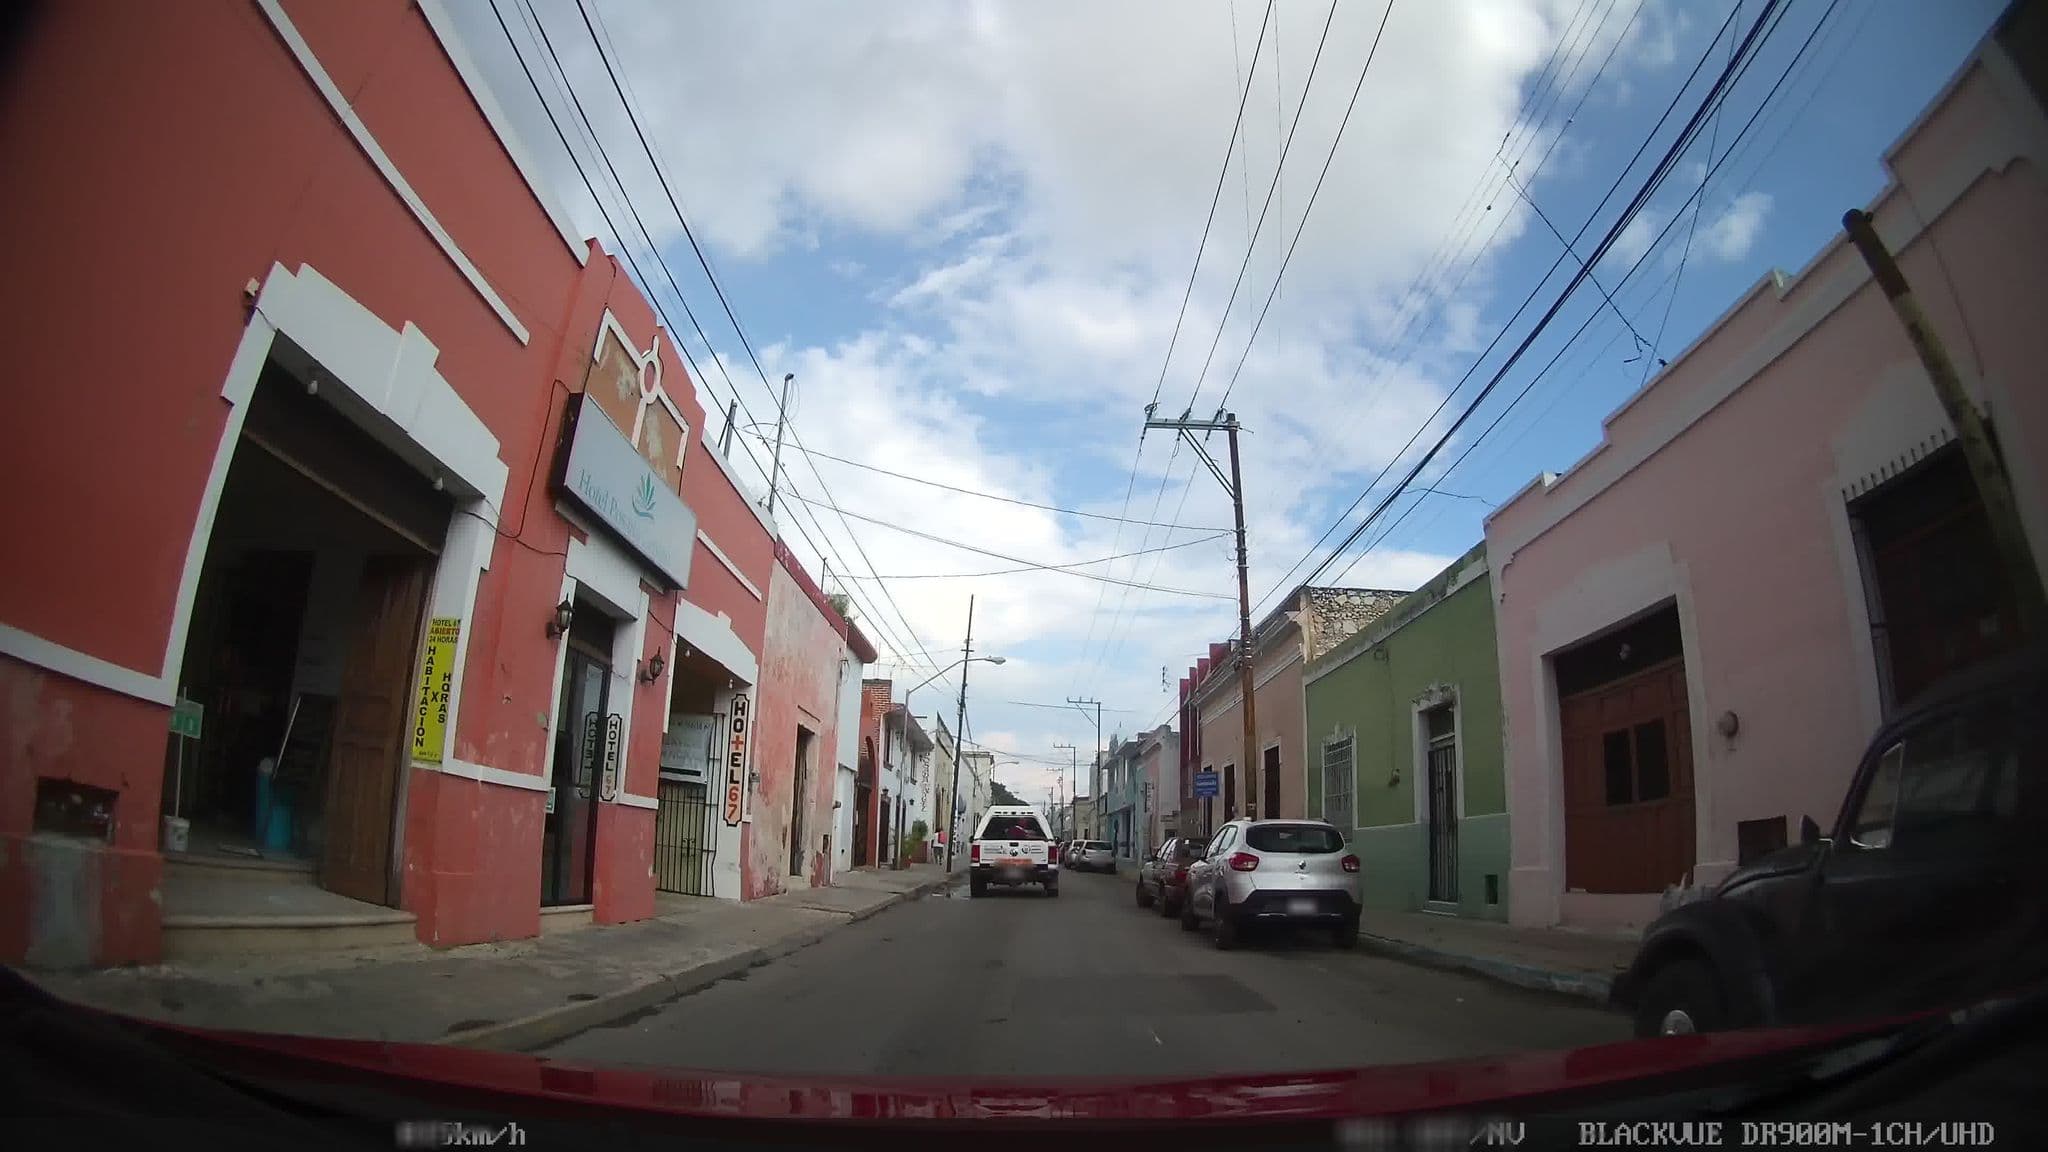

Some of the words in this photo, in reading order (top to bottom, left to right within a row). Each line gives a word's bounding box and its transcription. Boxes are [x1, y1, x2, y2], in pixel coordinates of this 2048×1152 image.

[577, 469, 608, 513] Hotel
[430, 691, 440, 703] X
[437, 672, 452, 724] HORAS
[605, 720, 618, 772] HOTEL
[728, 787, 741, 820] 67
